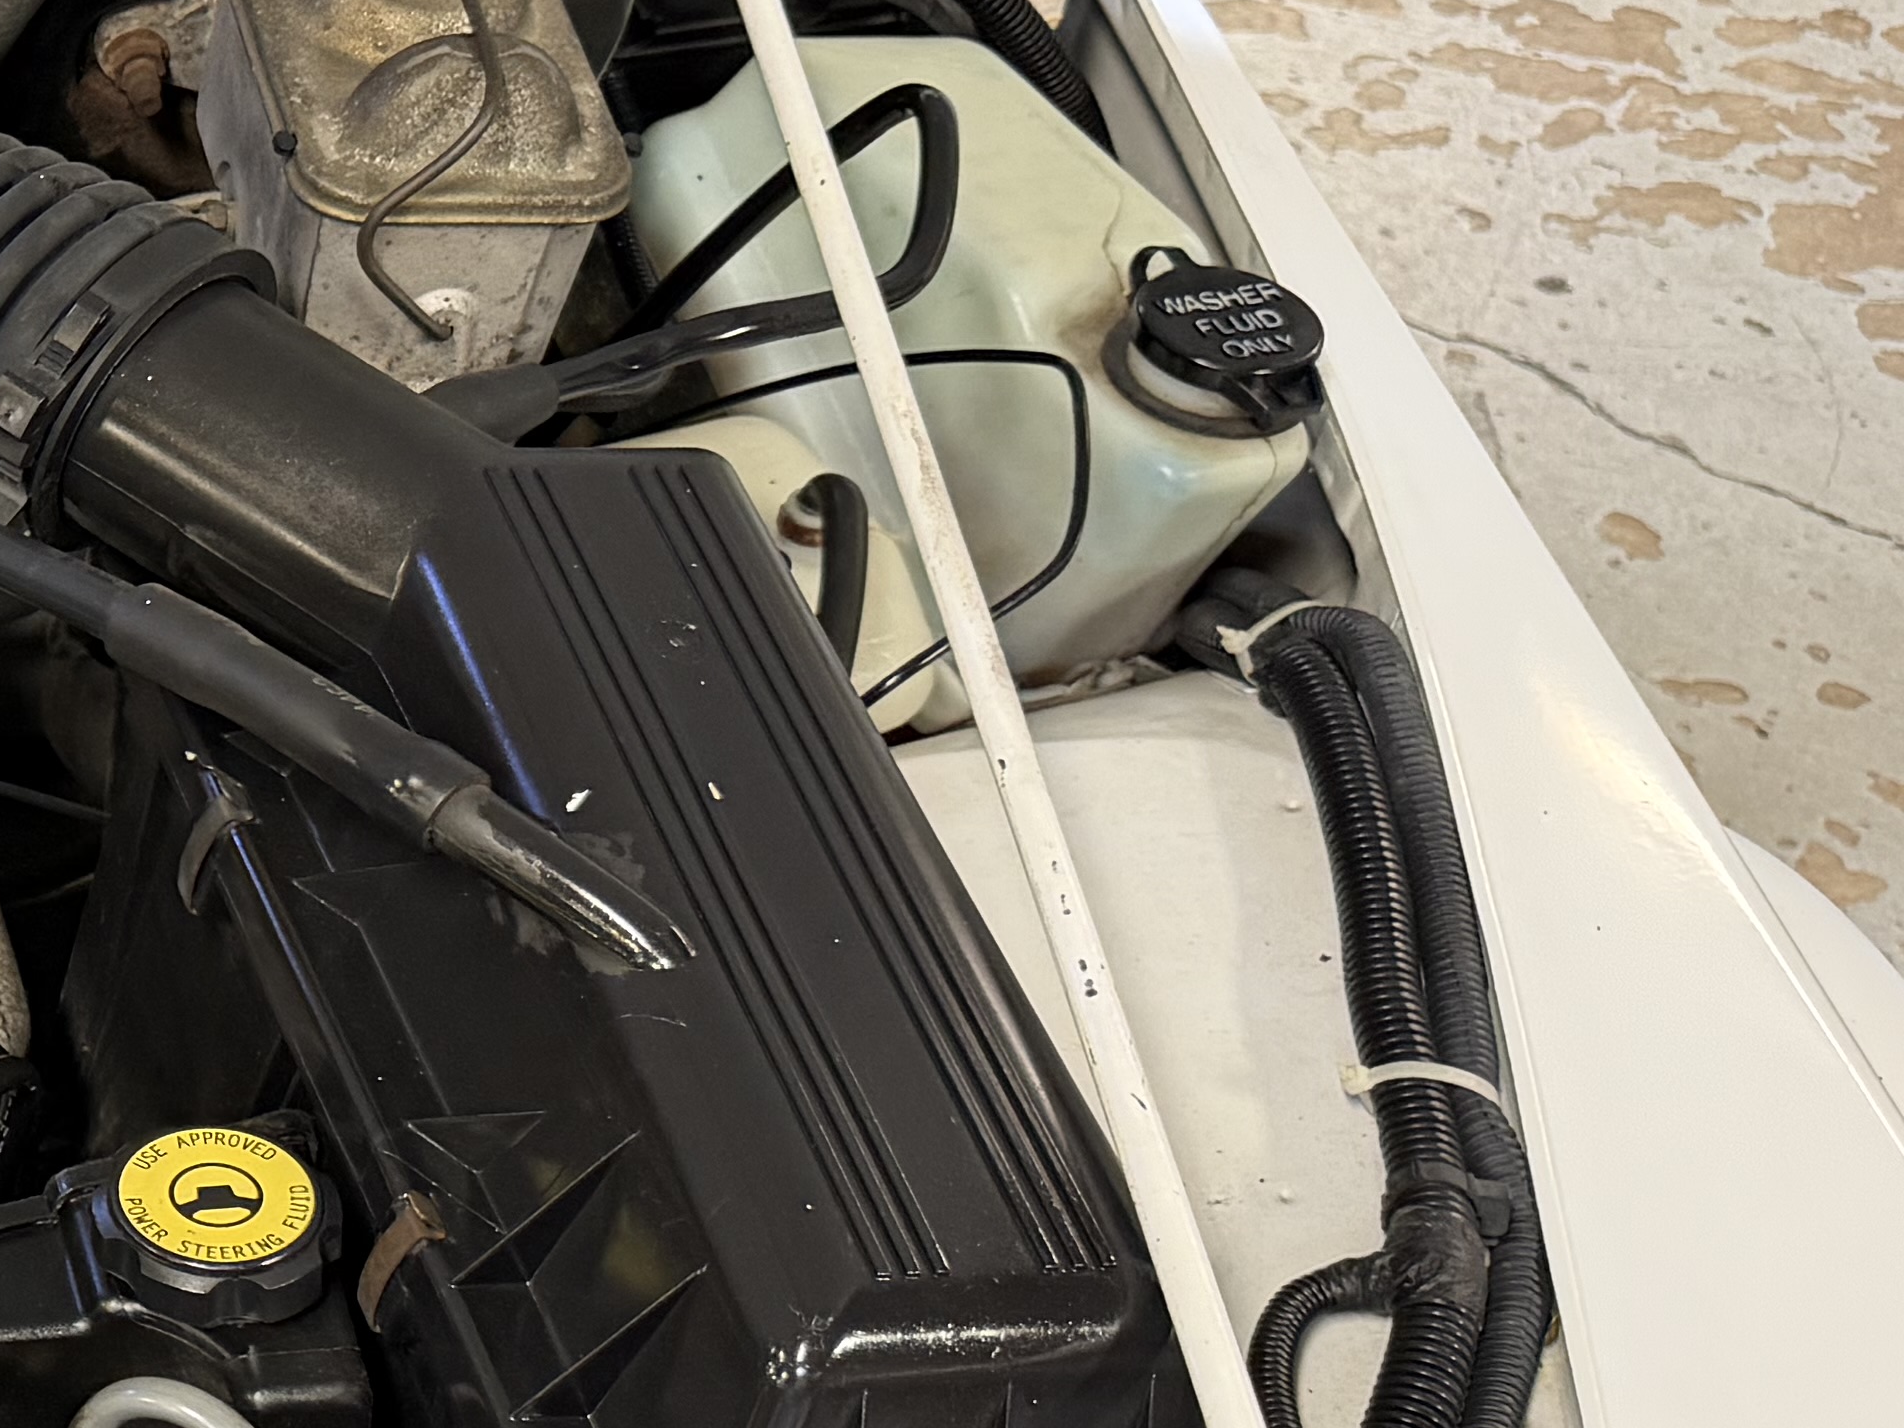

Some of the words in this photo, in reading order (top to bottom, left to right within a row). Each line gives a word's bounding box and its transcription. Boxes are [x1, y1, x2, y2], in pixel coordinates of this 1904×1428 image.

[1158, 281, 1283, 316] WASHER
[1195, 309, 1284, 338] FLUID
[1221, 333, 1294, 360] ONLY
[132, 1143, 168, 1171] USE
[177, 1131, 277, 1162] APPROVED
[124, 1197, 169, 1242] POWER
[177, 1233, 285, 1260] STEERING
[282, 1184, 312, 1231] FLUID
